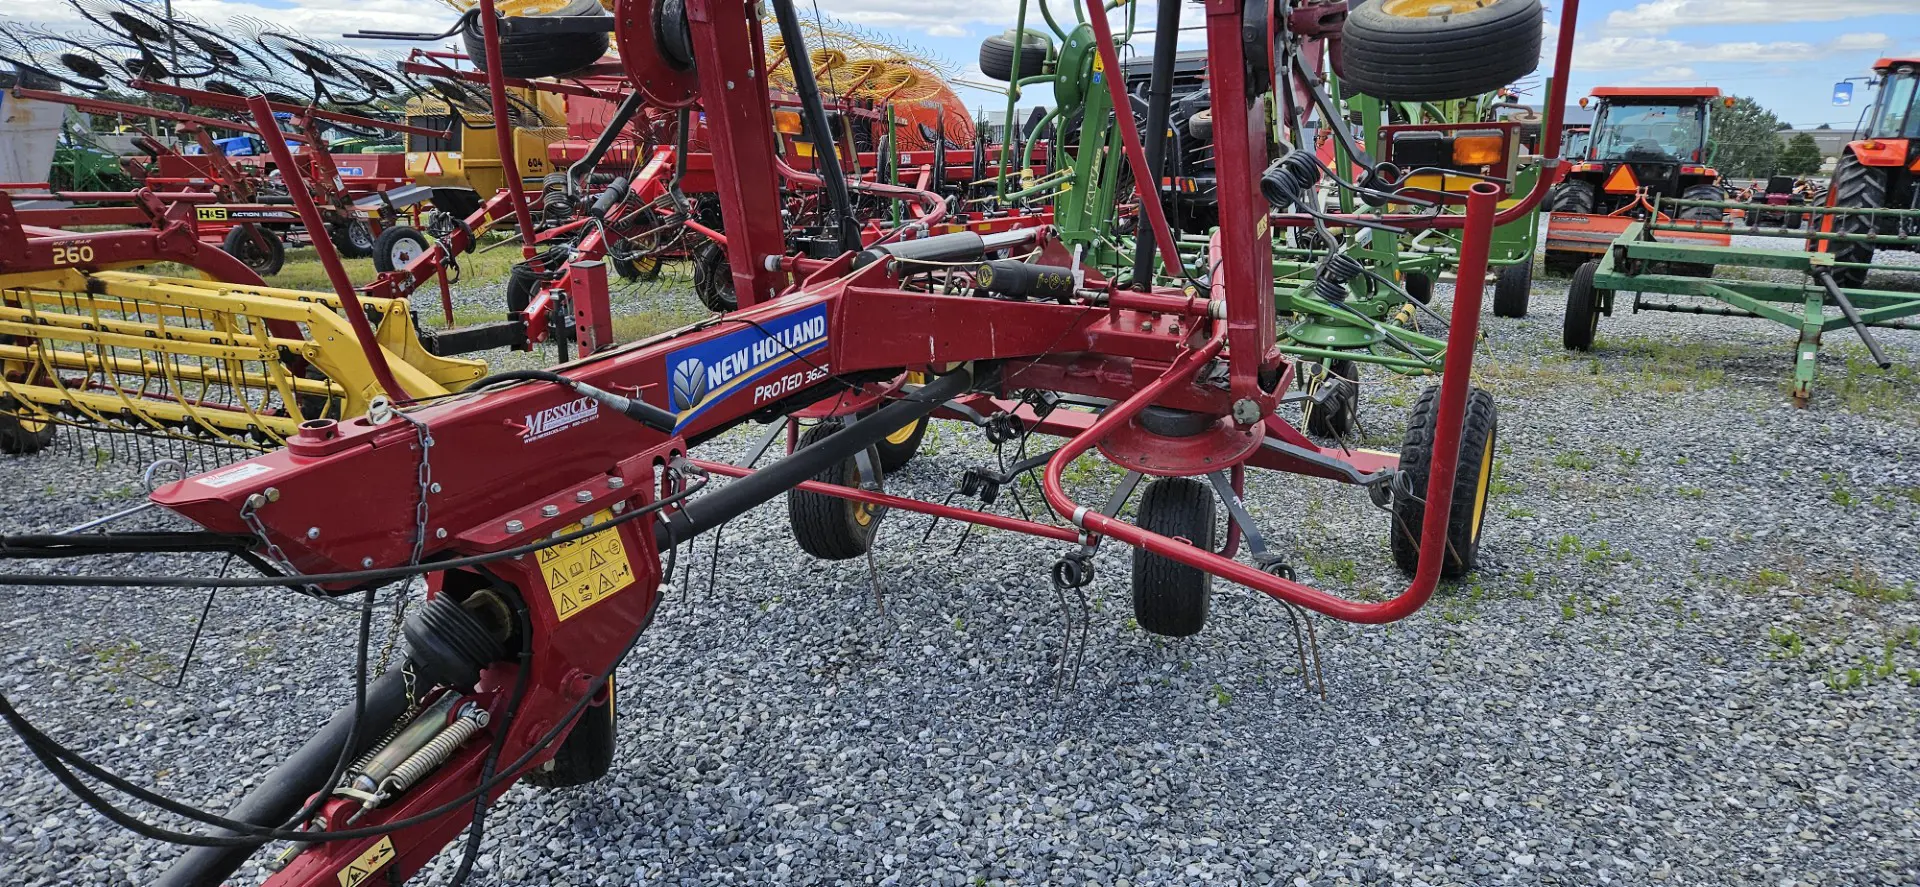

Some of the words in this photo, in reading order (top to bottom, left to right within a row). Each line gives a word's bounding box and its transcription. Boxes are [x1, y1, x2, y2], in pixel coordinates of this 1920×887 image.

[528, 158, 543, 168] 604
[199, 209, 226, 219] H&S
[52, 246, 94, 265] 260
[707, 347, 749, 390] NEW
[752, 315, 825, 365] HOLLAND
